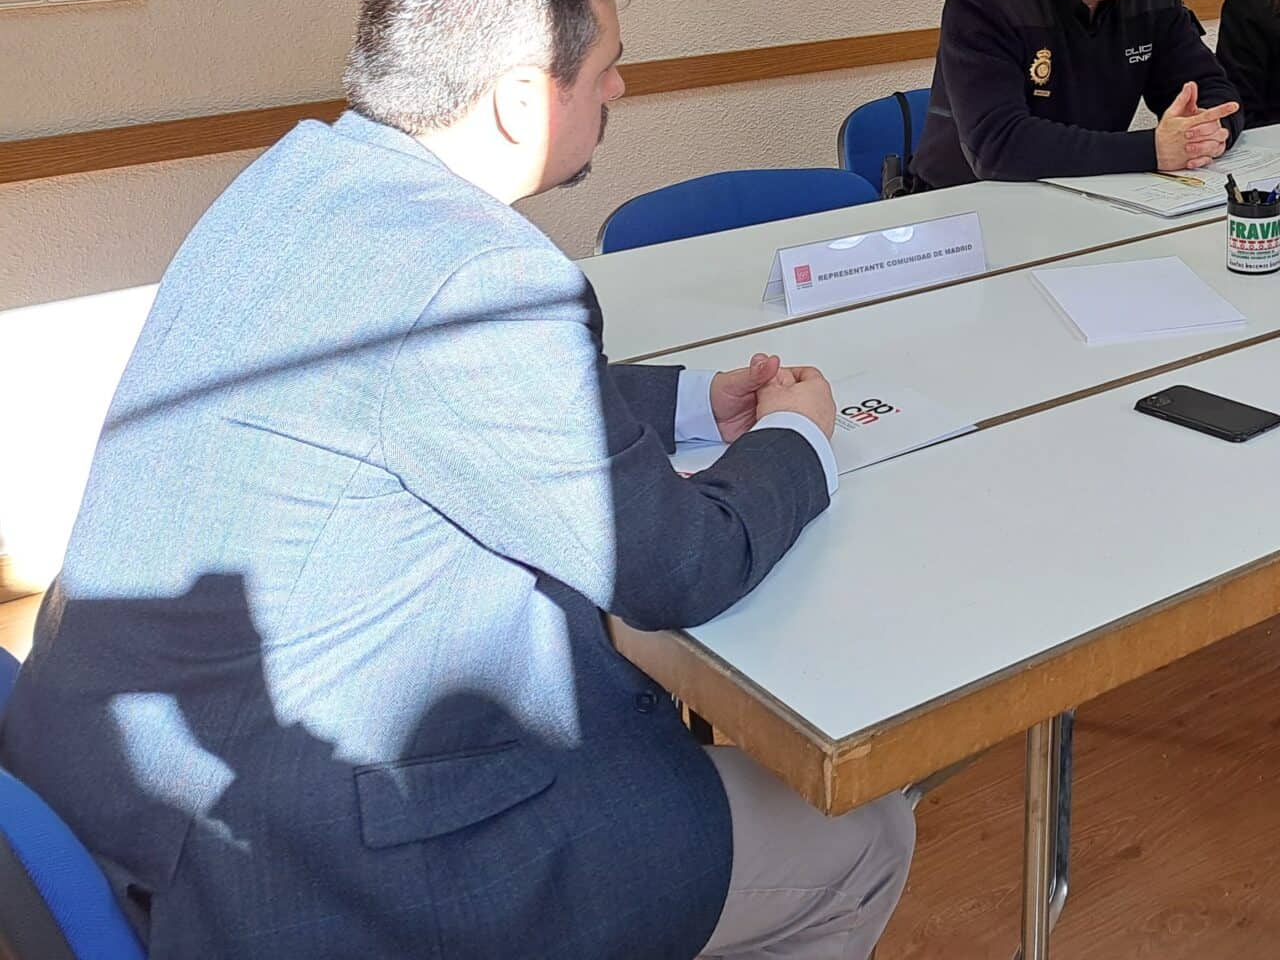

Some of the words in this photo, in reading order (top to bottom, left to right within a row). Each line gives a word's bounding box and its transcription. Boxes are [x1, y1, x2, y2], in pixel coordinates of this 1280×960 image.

[1230, 219, 1280, 240] FRAVM
[817, 261, 885, 282] REPRESENTANTE
[886, 251, 932, 268] COMUNIDAD
[933, 249, 943, 259] DE
[944, 243, 973, 256] MADRID
